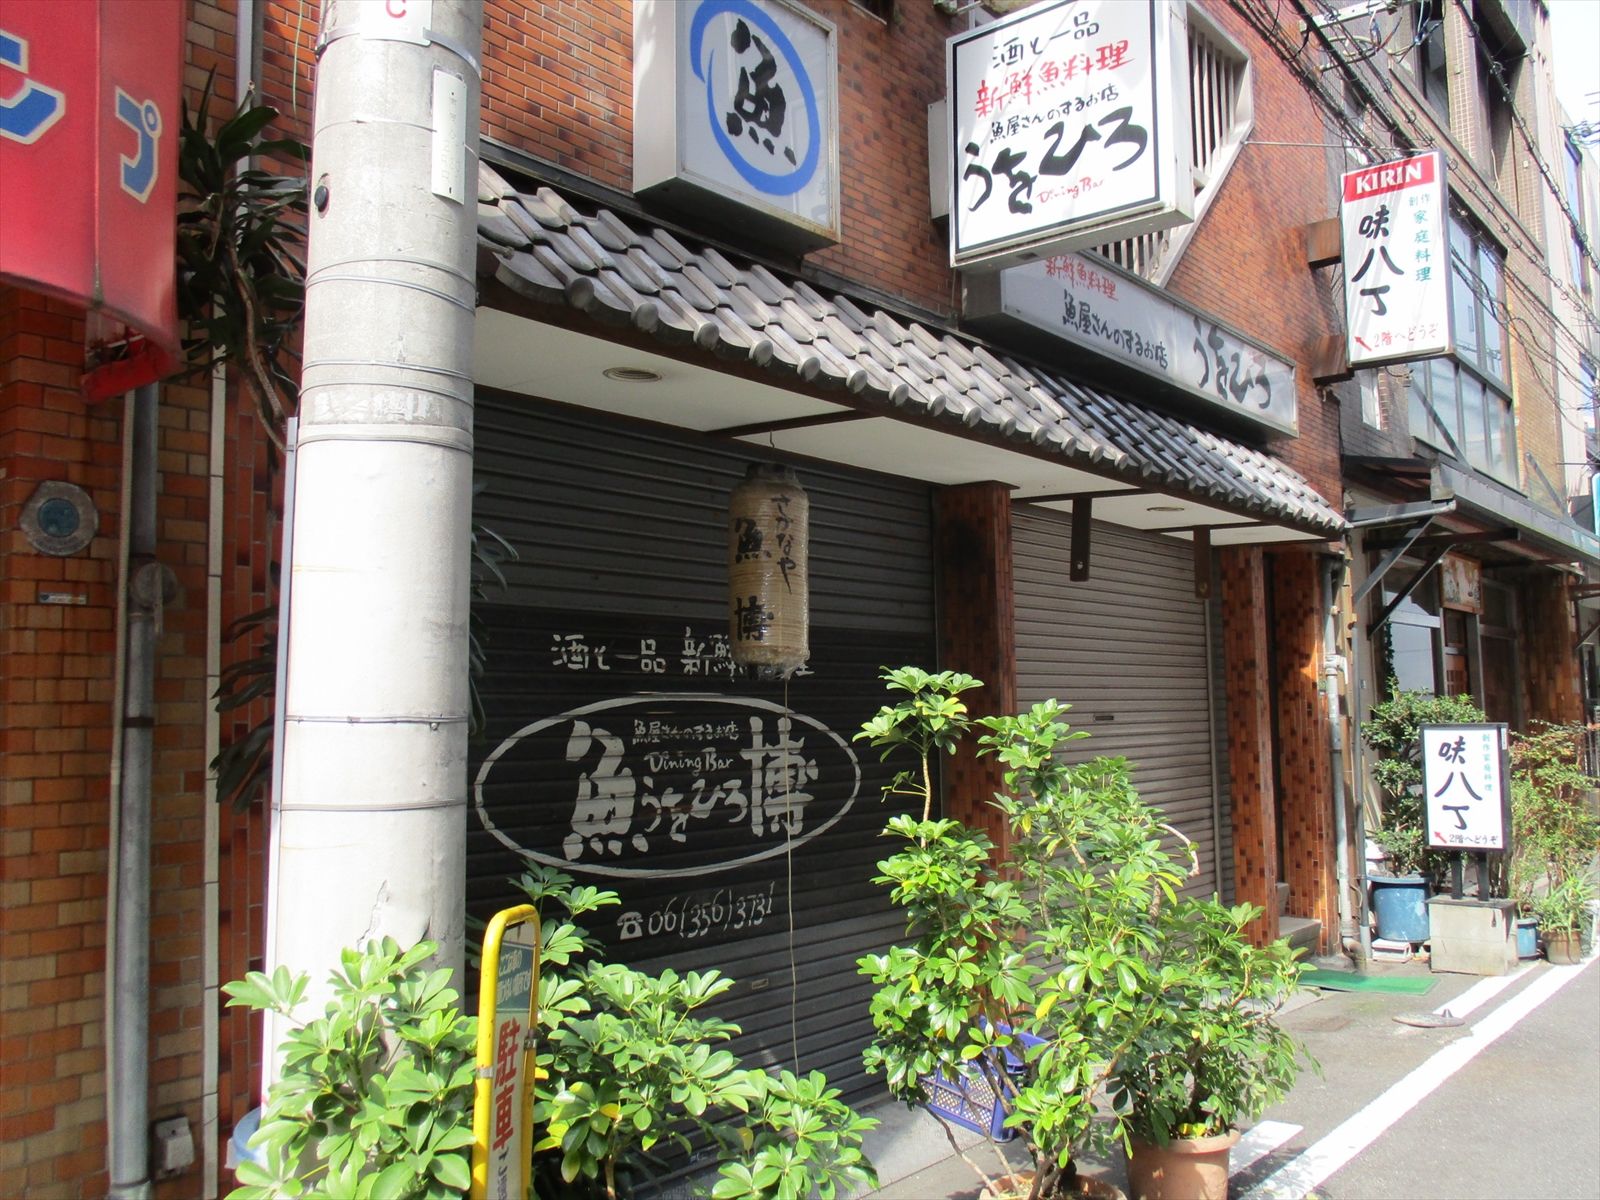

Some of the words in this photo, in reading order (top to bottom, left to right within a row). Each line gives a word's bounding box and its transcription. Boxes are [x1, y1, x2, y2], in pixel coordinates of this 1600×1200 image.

[974, 39, 1134, 118] 新鮮魚料理
[992, 11, 1099, 69] 酒と一品
[726, 18, 796, 167] 魚
[989, 83, 1119, 144] 魚屋さんのするお店
[1356, 161, 1422, 194] KIRIN
[1351, 204, 1404, 316] 味八丁
[1414, 210, 1432, 282] 家庭料理
[1063, 289, 1169, 371] 魚屋さんのするお店
[771, 493, 796, 595] さかなや
[551, 633, 667, 674] 酒と一品
[644, 750, 702, 777] Dining
[701, 747, 734, 771] Bar
[1434, 735, 1483, 830] 味八丁
[493, 1017, 520, 1151] 駐車
